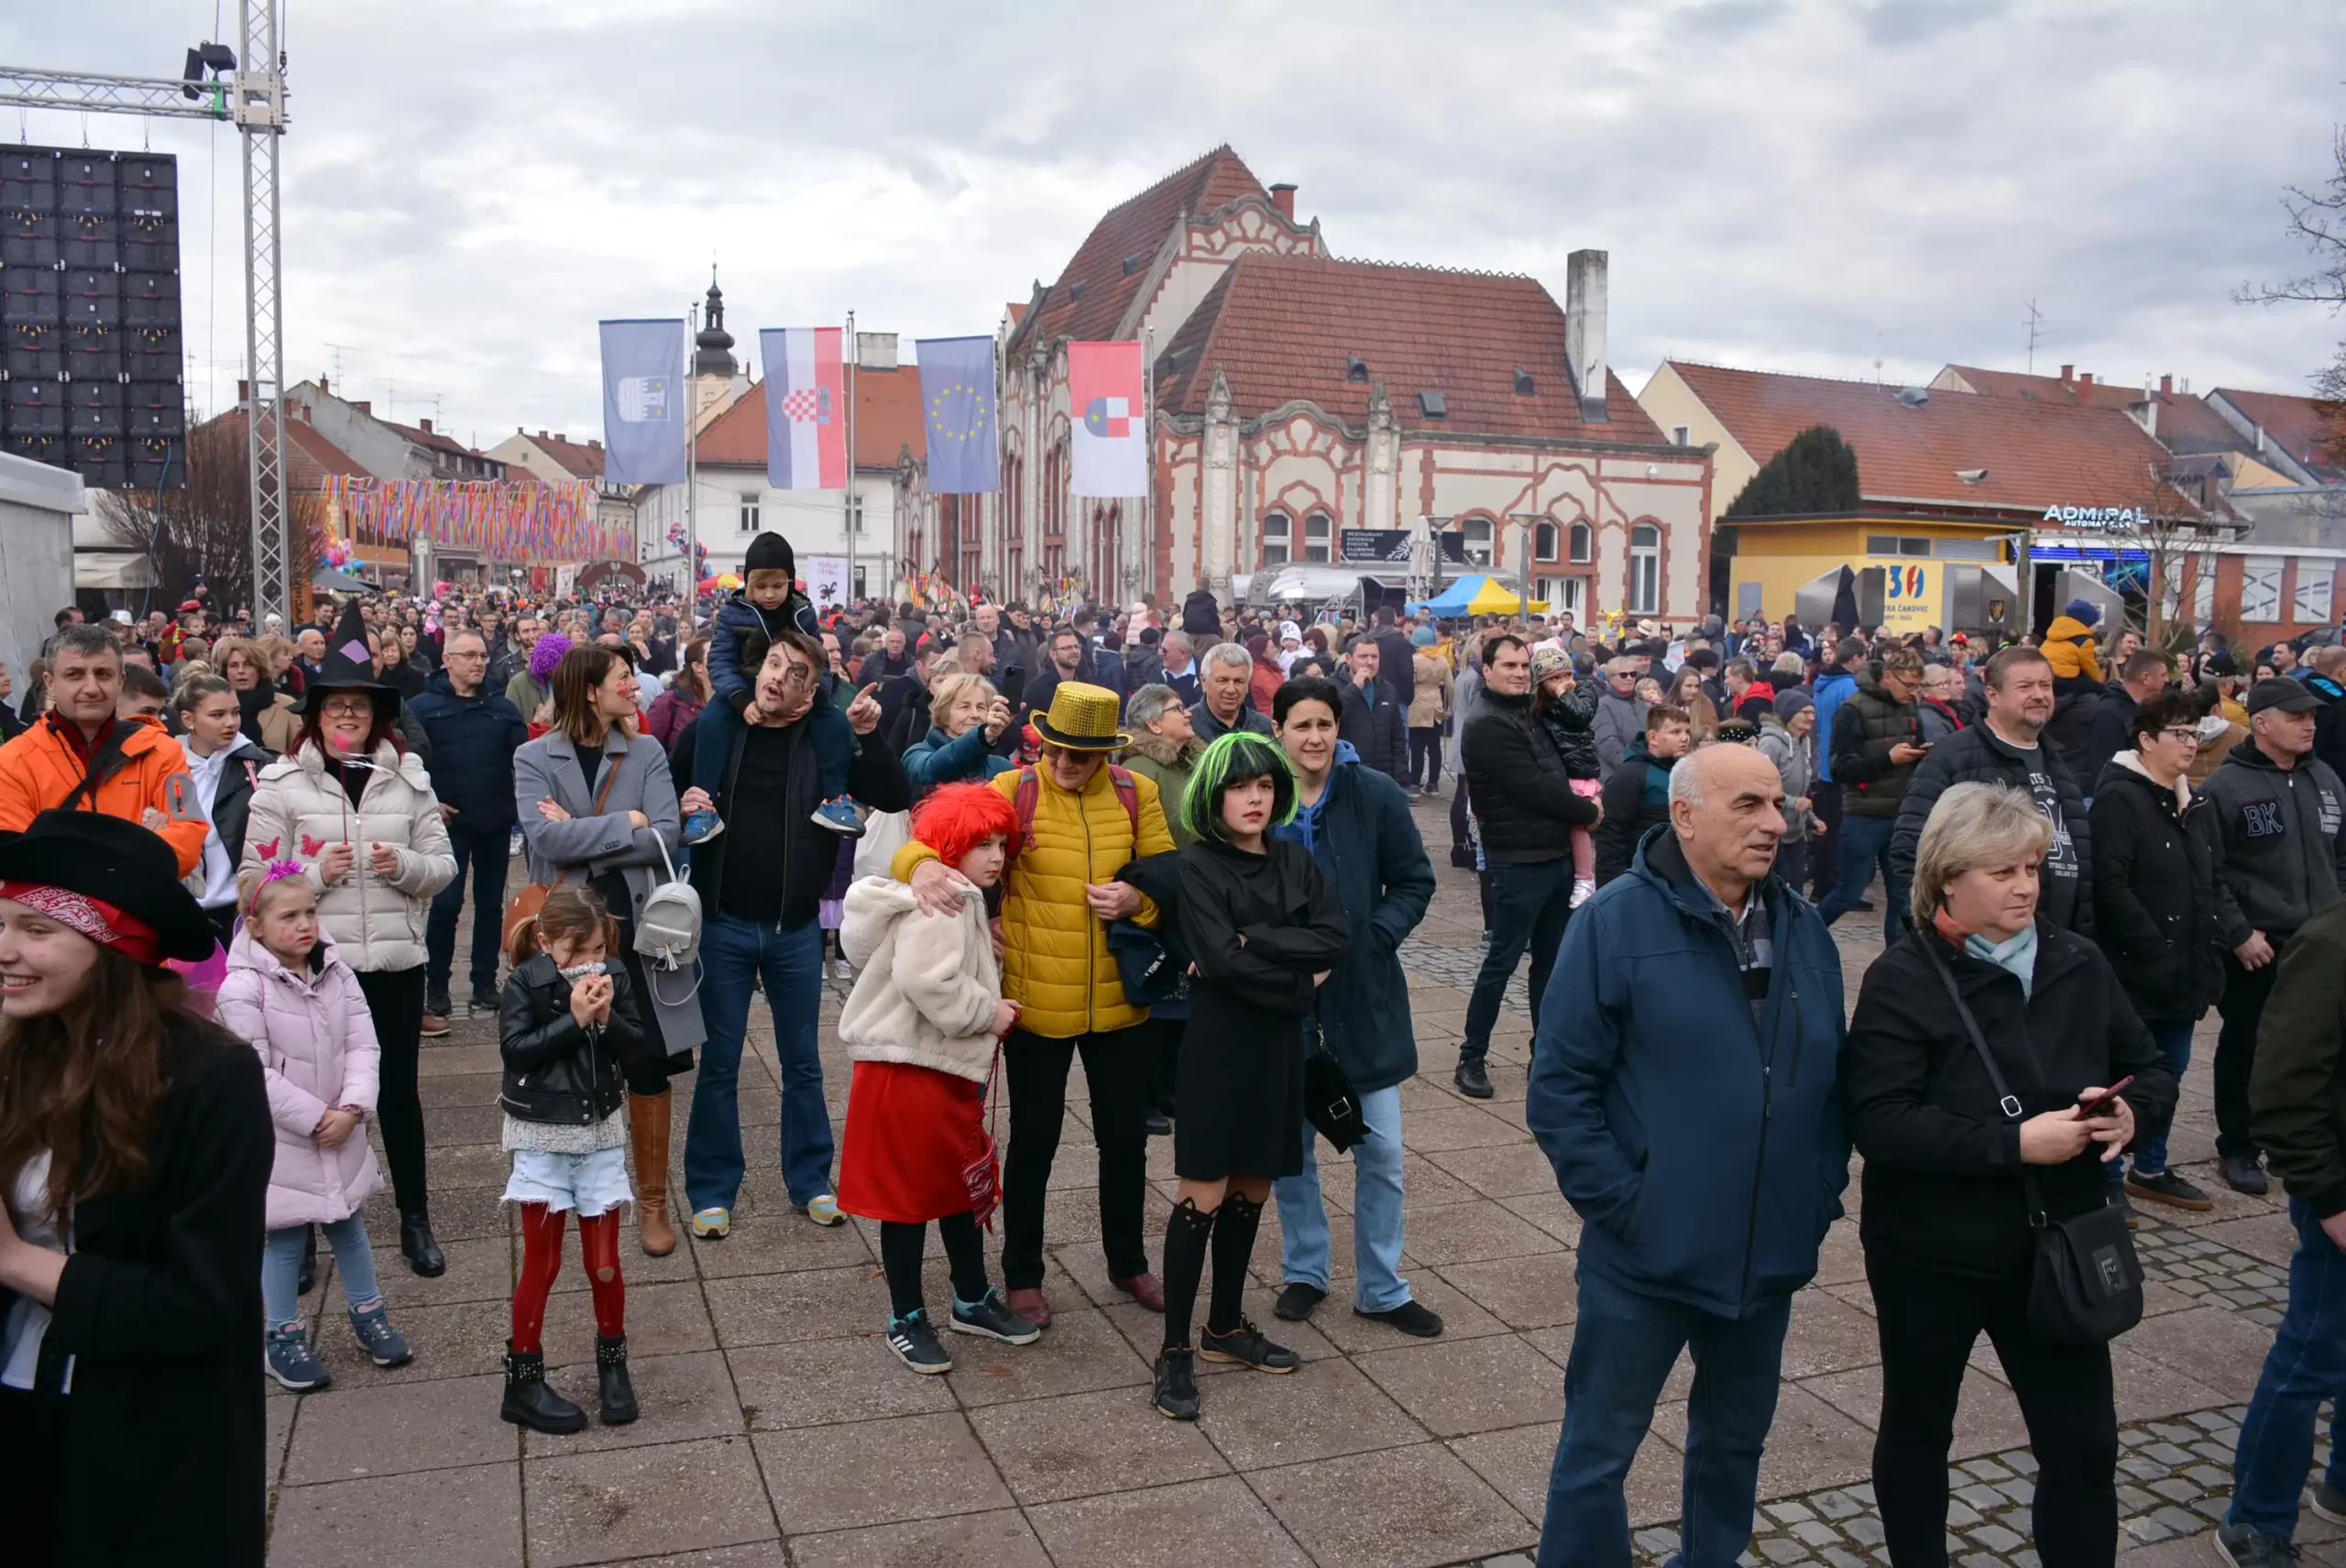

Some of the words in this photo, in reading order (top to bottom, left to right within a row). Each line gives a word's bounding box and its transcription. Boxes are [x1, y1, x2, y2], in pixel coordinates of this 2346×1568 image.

[2043, 504, 2150, 523] ADMIRAL
[1898, 604, 1928, 612] ČAKOVEC
[2243, 802, 2283, 837] BK
